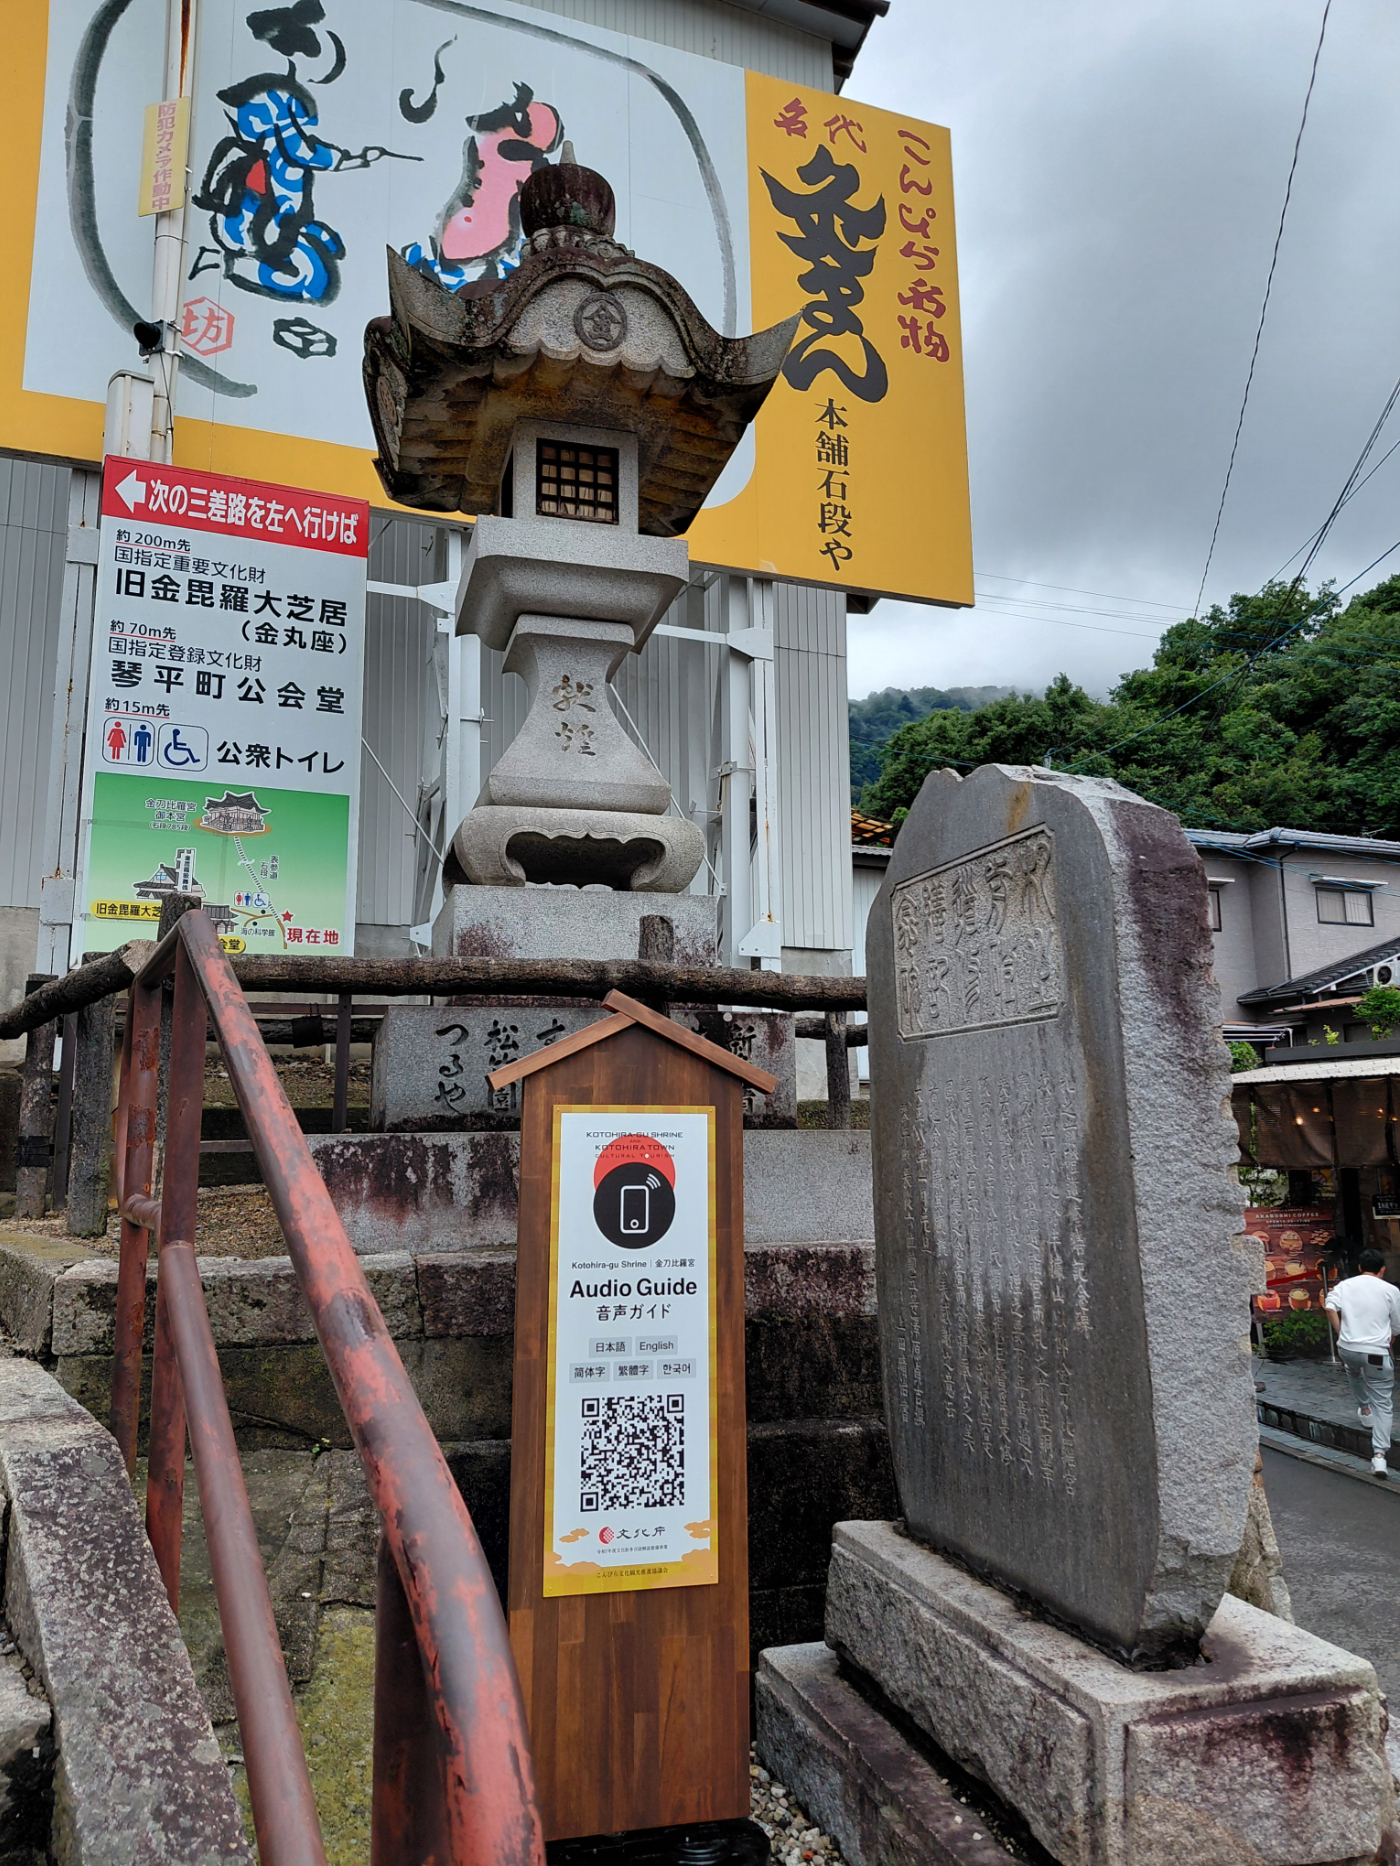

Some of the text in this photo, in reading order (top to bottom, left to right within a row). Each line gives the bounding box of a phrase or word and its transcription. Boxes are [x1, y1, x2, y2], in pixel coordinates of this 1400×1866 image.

[773, 97, 867, 154] 名代
[152, 103, 177, 210] 防犯カメラ作動中
[814, 398, 854, 571] 本舗石段や
[148, 479, 359, 545] 次の三差路を左へ行けば
[114, 545, 267, 584] 国指定重要文化財
[108, 637, 263, 673] 国指定登録文化財
[110, 660, 345, 714] 琴平町公会堂
[216, 740, 345, 774] 公衆トイレ
[145, 798, 197, 812] 金刀比羅宮
[155, 810, 186, 822] 御本宮
[240, 928, 276, 938] 海の科学館
[286, 927, 340, 946] 現在地
[434, 1023, 470, 1115] つるや
[586, 1131, 649, 1139] KOTOHIRA-GU
[571, 1258, 696, 1270] Kotohira-gu Shrine 金刀比羅宮
[570, 1278, 698, 1299] Audio Guide
[596, 1304, 672, 1322] 音声ガイド
[595, 1342, 626, 1353] 日本語
[639, 1341, 674, 1353] English
[574, 1366, 606, 1378] 简体字
[662, 1363, 691, 1375] 한국어
[616, 1526, 666, 1540] 文化庁
